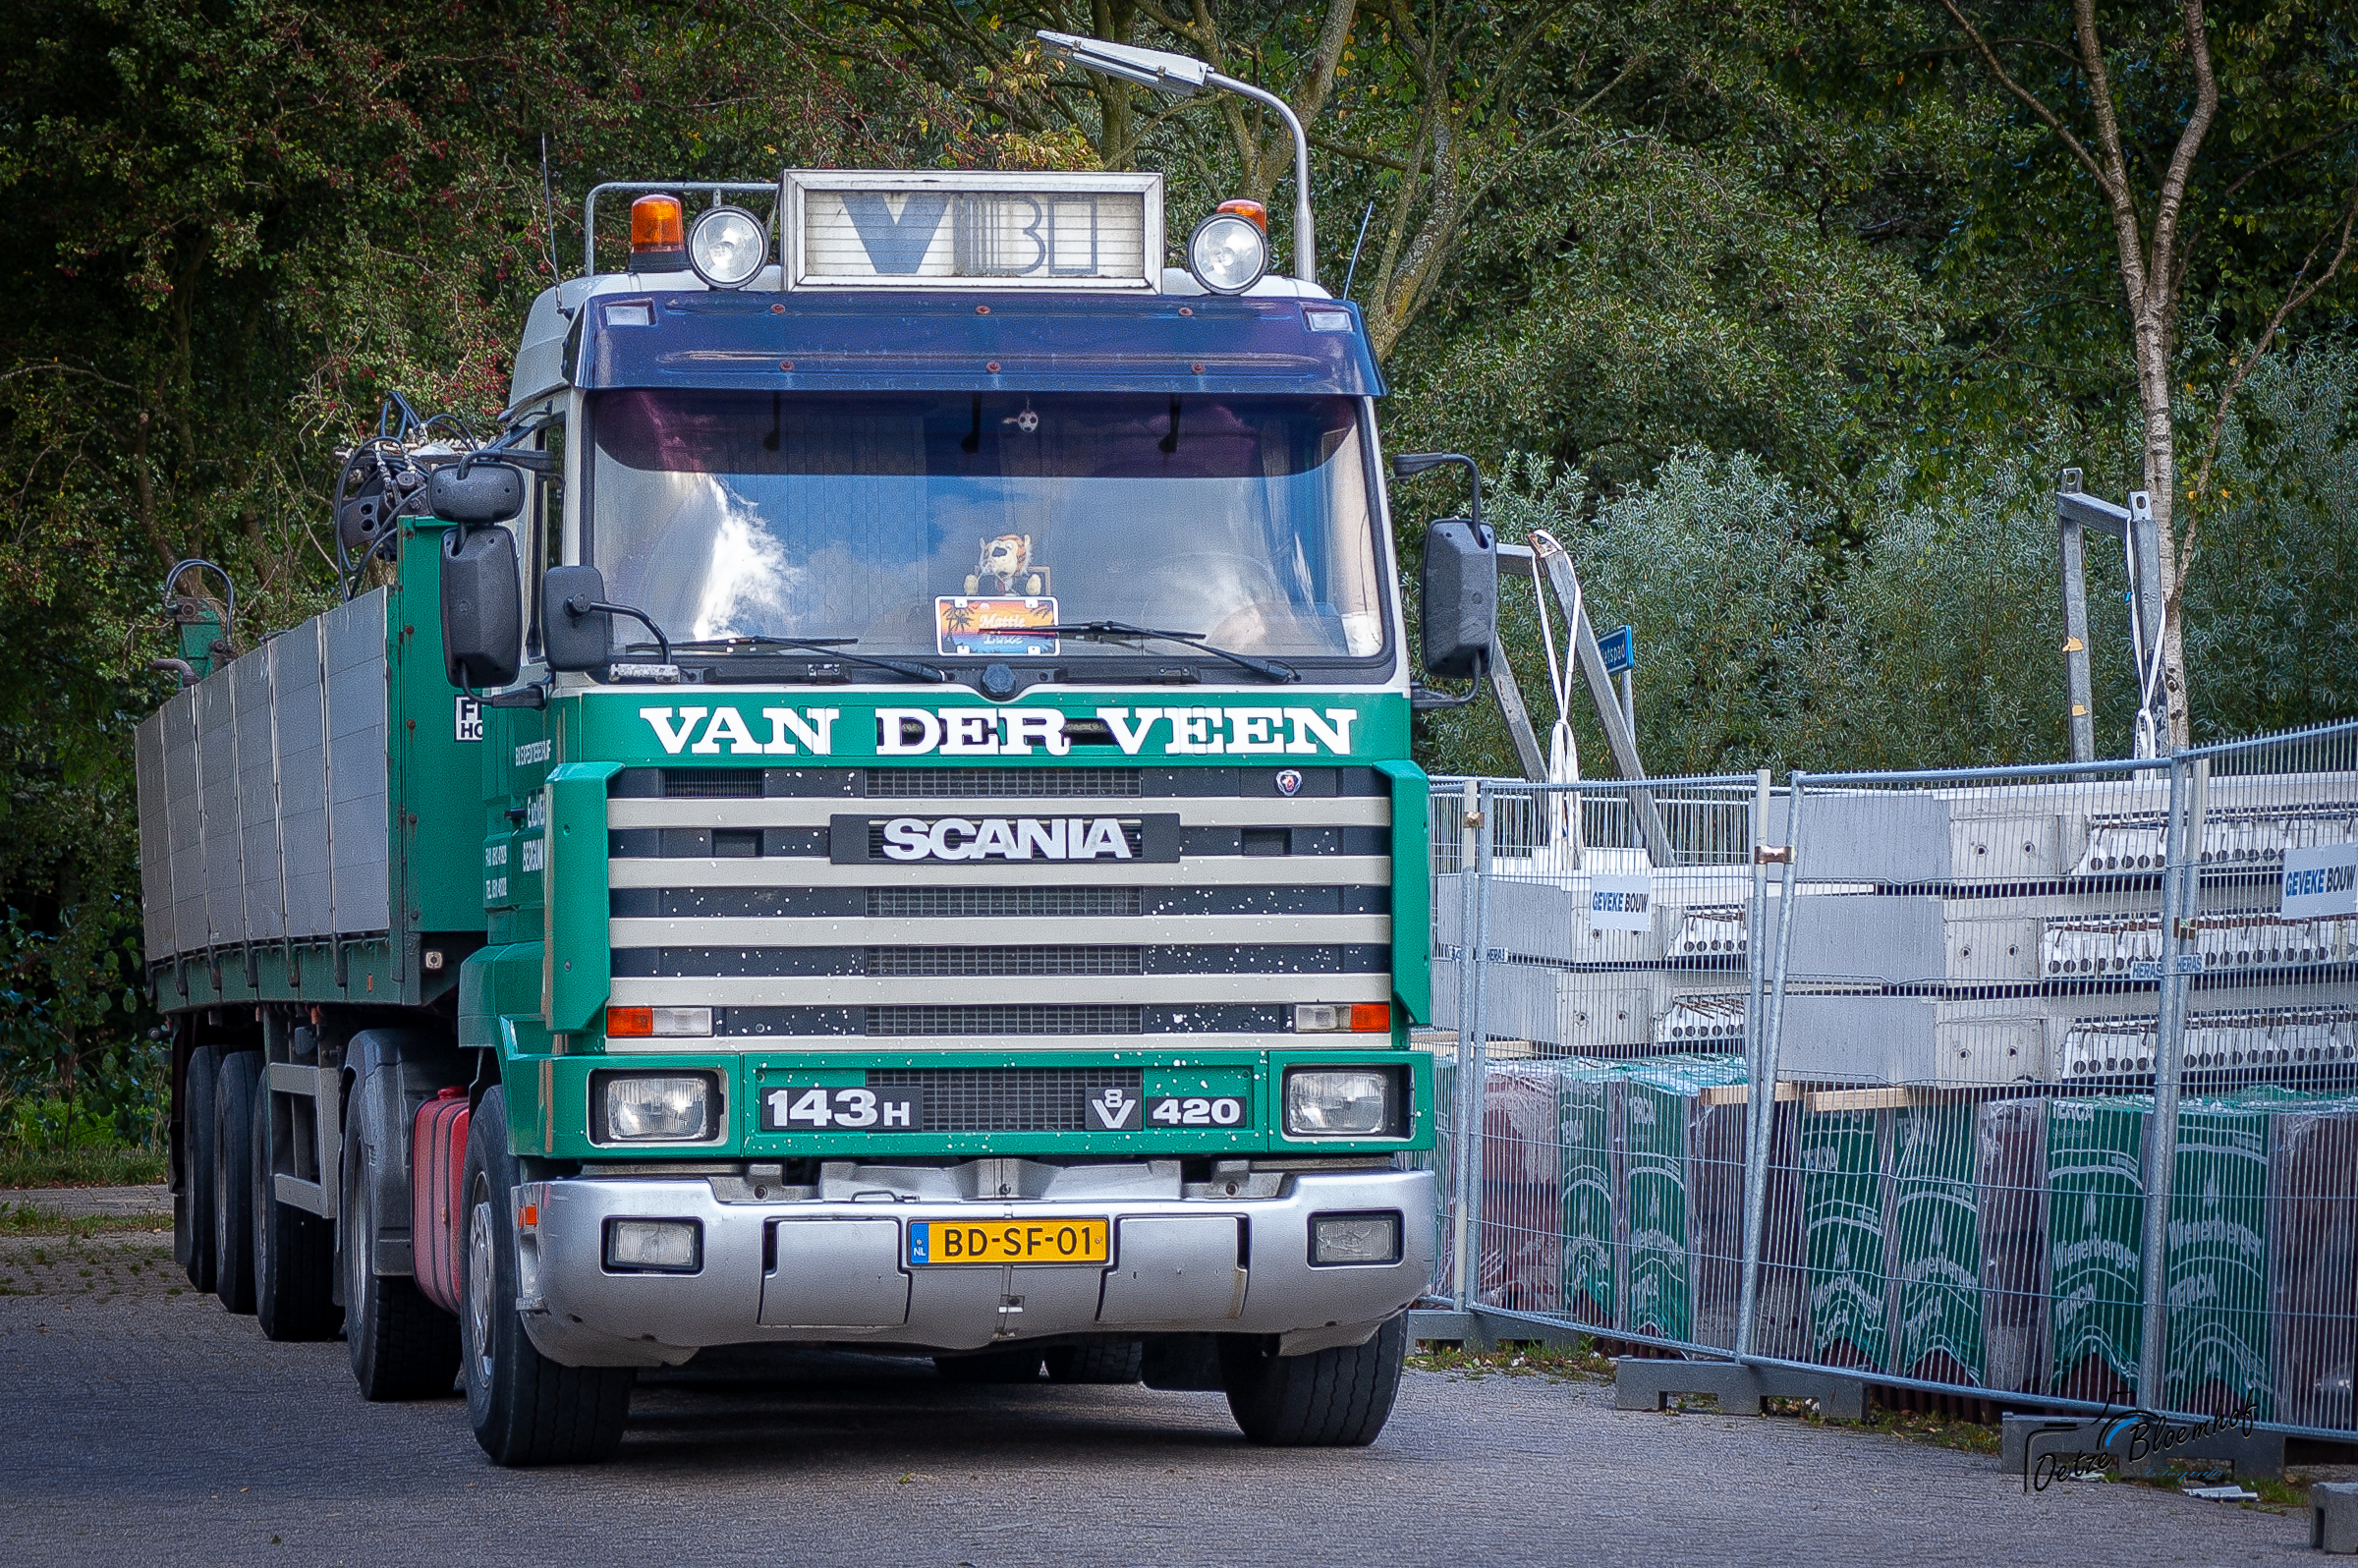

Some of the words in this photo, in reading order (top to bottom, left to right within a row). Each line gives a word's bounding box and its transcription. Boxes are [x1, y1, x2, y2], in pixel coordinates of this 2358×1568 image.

[639, 705, 841, 756] VAN
[874, 706, 1070, 756] DER
[1095, 706, 1358, 756] VEEN
[882, 816, 1132, 861] SCANIA
[2285, 868, 2326, 897] GEVEKE
[2326, 864, 2357, 893] BOUW
[1593, 891, 1624, 912] GEVEKE
[1625, 892, 1649, 914] BOUW
[1152, 1098, 1241, 1125] 420
[913, 1247, 926, 1257] NL
[944, 1226, 1092, 1258] BD-SF-01
